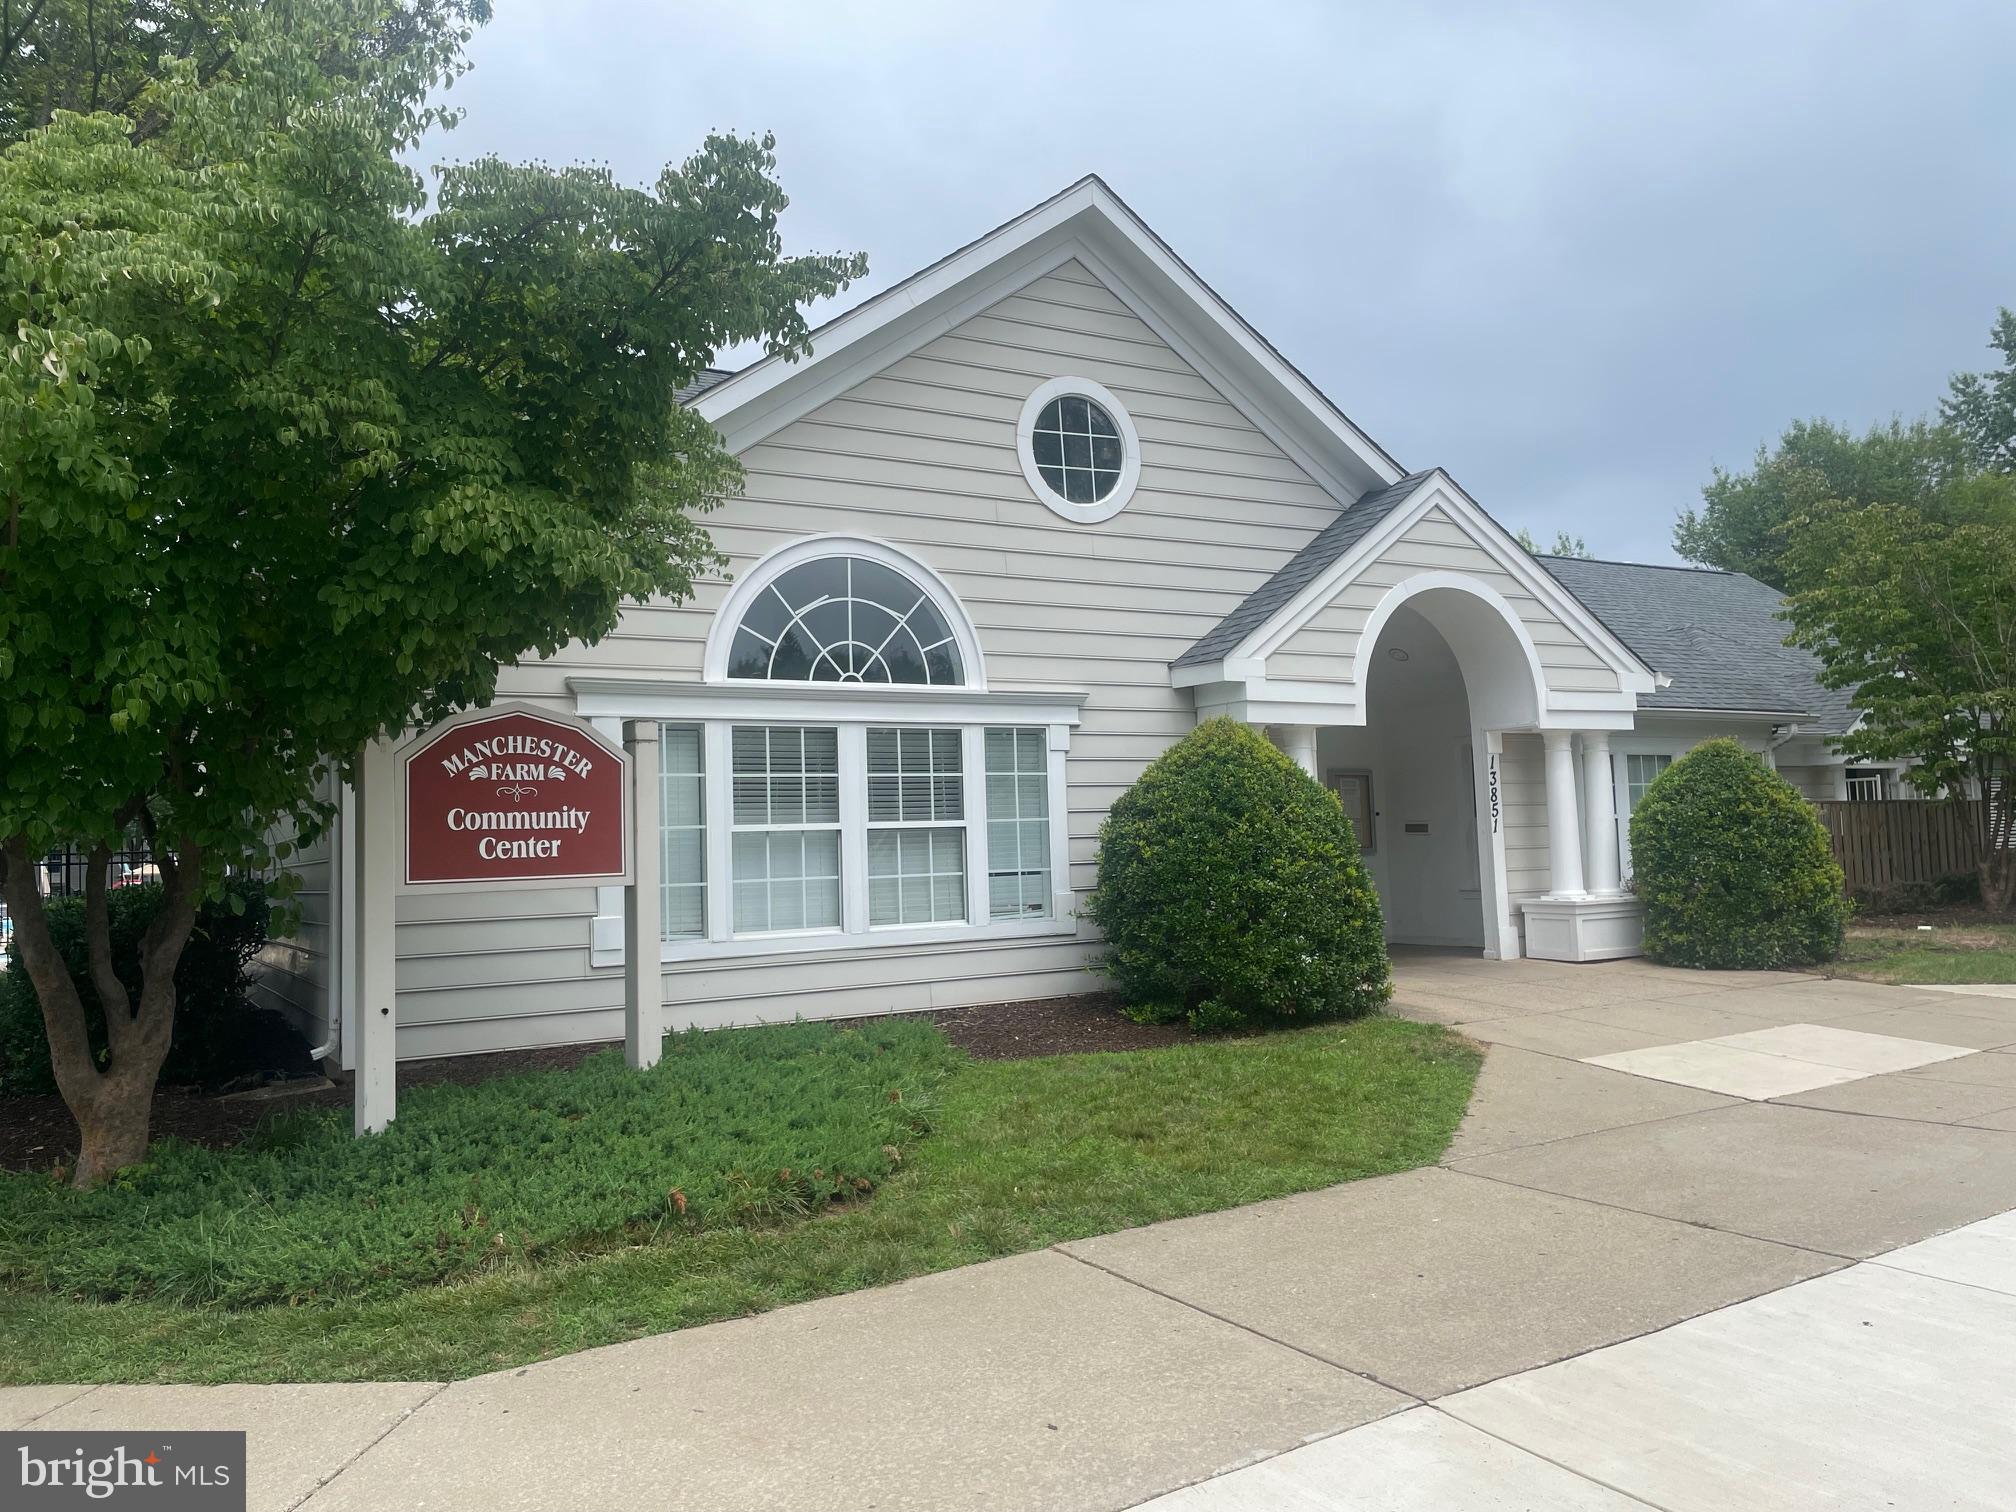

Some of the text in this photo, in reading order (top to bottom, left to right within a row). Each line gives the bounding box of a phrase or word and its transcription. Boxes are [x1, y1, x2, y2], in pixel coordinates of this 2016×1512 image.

[440, 735, 593, 780] MANCHESTER
[490, 763, 545, 781] FARM
[1489, 755, 1499, 833] 13851
[447, 805, 591, 834] Community
[478, 837, 562, 860] Center
